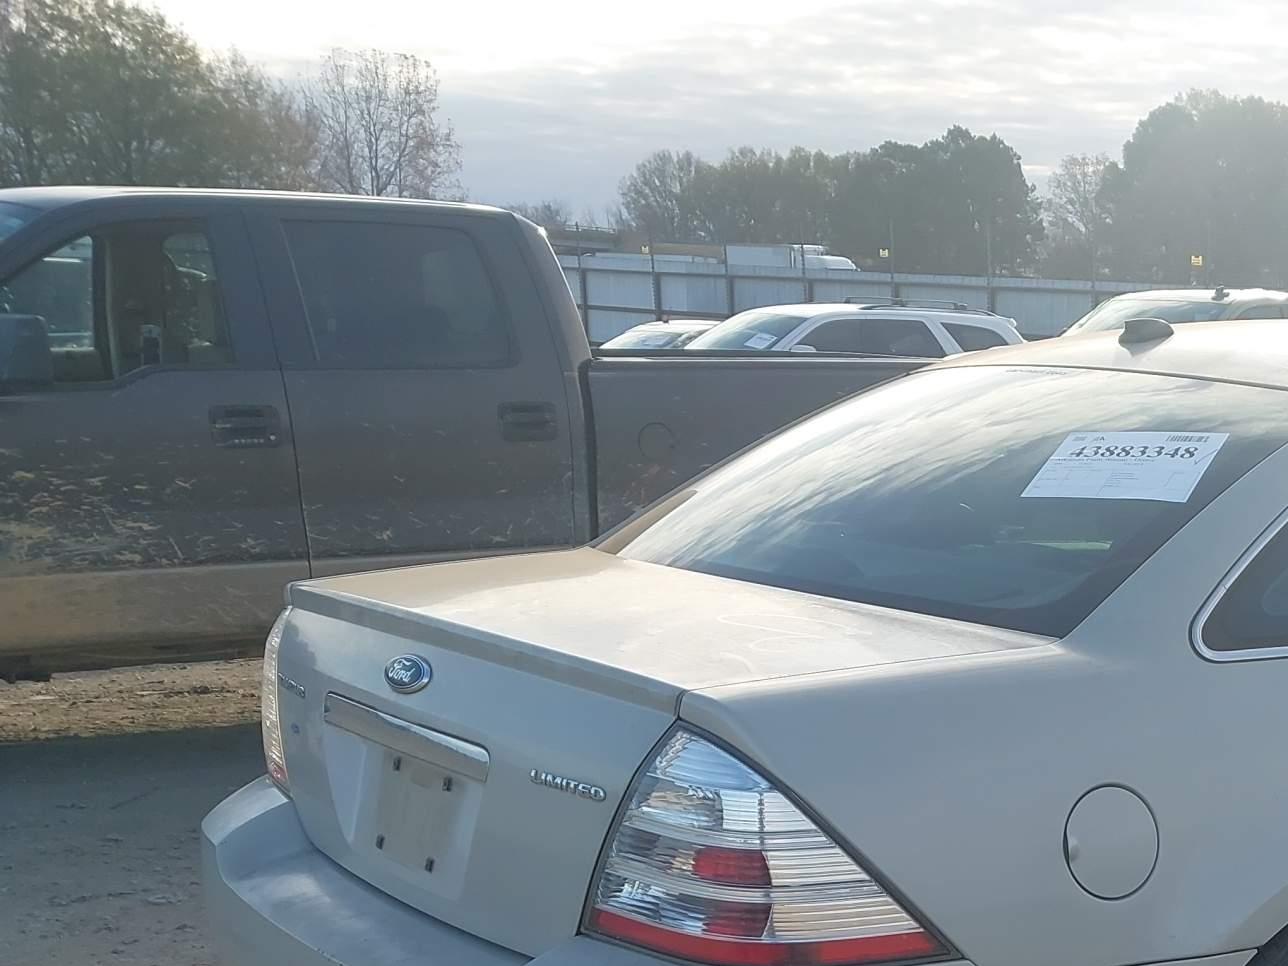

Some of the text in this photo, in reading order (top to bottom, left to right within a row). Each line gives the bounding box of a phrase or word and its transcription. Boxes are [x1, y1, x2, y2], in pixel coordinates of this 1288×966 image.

[1069, 445, 1199, 459] 43883348
[388, 658, 416, 683] Ford
[529, 768, 607, 801] LIMITED
